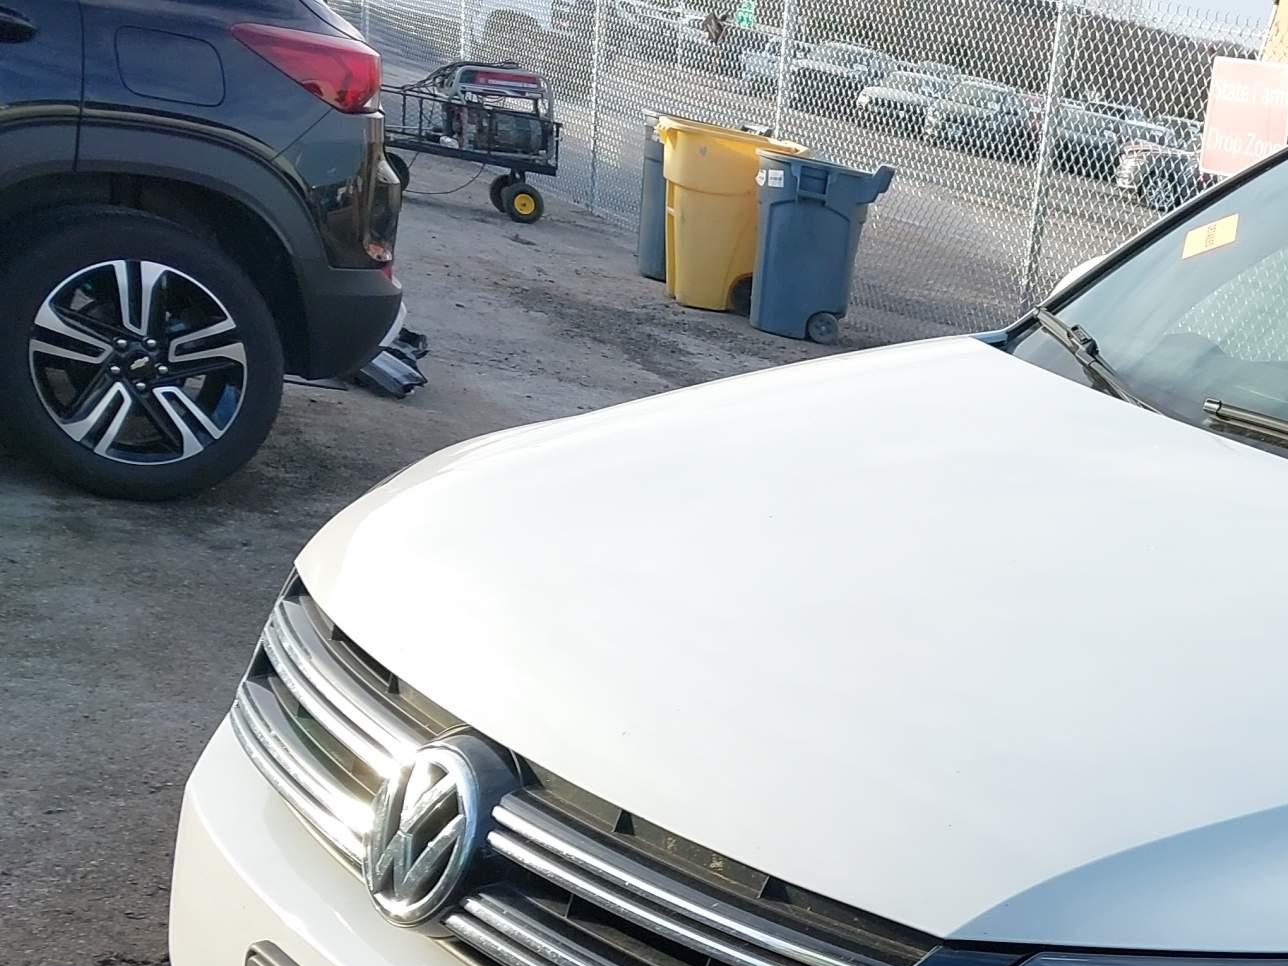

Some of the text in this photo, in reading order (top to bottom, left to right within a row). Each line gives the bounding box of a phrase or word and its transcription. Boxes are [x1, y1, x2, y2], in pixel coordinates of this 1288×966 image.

[1214, 79, 1288, 109] State Farm
[1206, 127, 1243, 159] Drop
